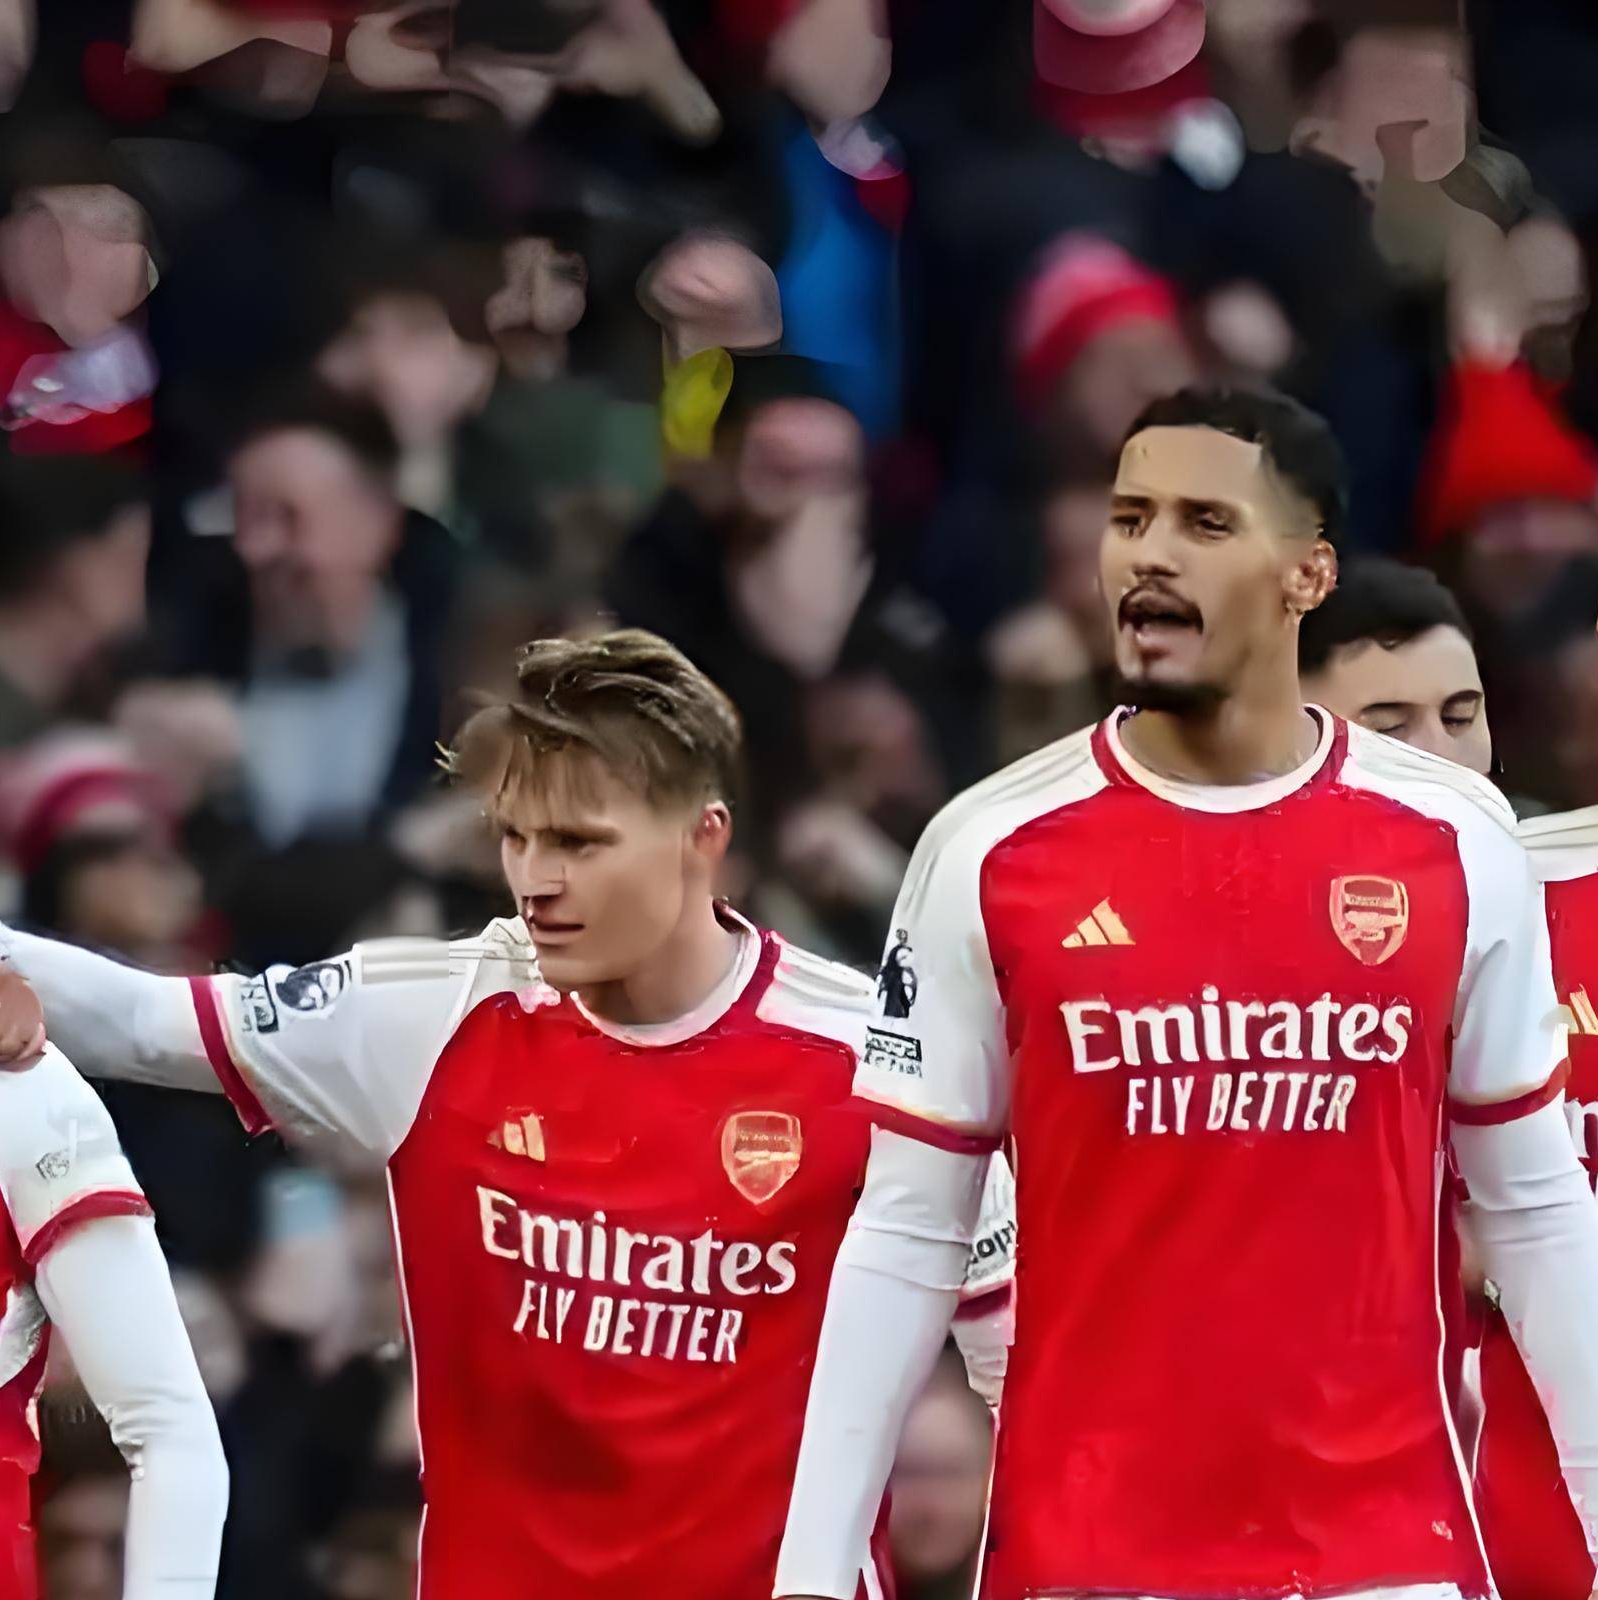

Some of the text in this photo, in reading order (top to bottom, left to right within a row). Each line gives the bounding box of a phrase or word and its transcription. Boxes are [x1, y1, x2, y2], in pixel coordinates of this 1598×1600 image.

[1058, 983, 1412, 1074] Emirates
[1127, 1071, 1357, 1136] FLY BETTER
[476, 1185, 797, 1296] Emirates
[512, 1279, 744, 1364] FLY BETTER
